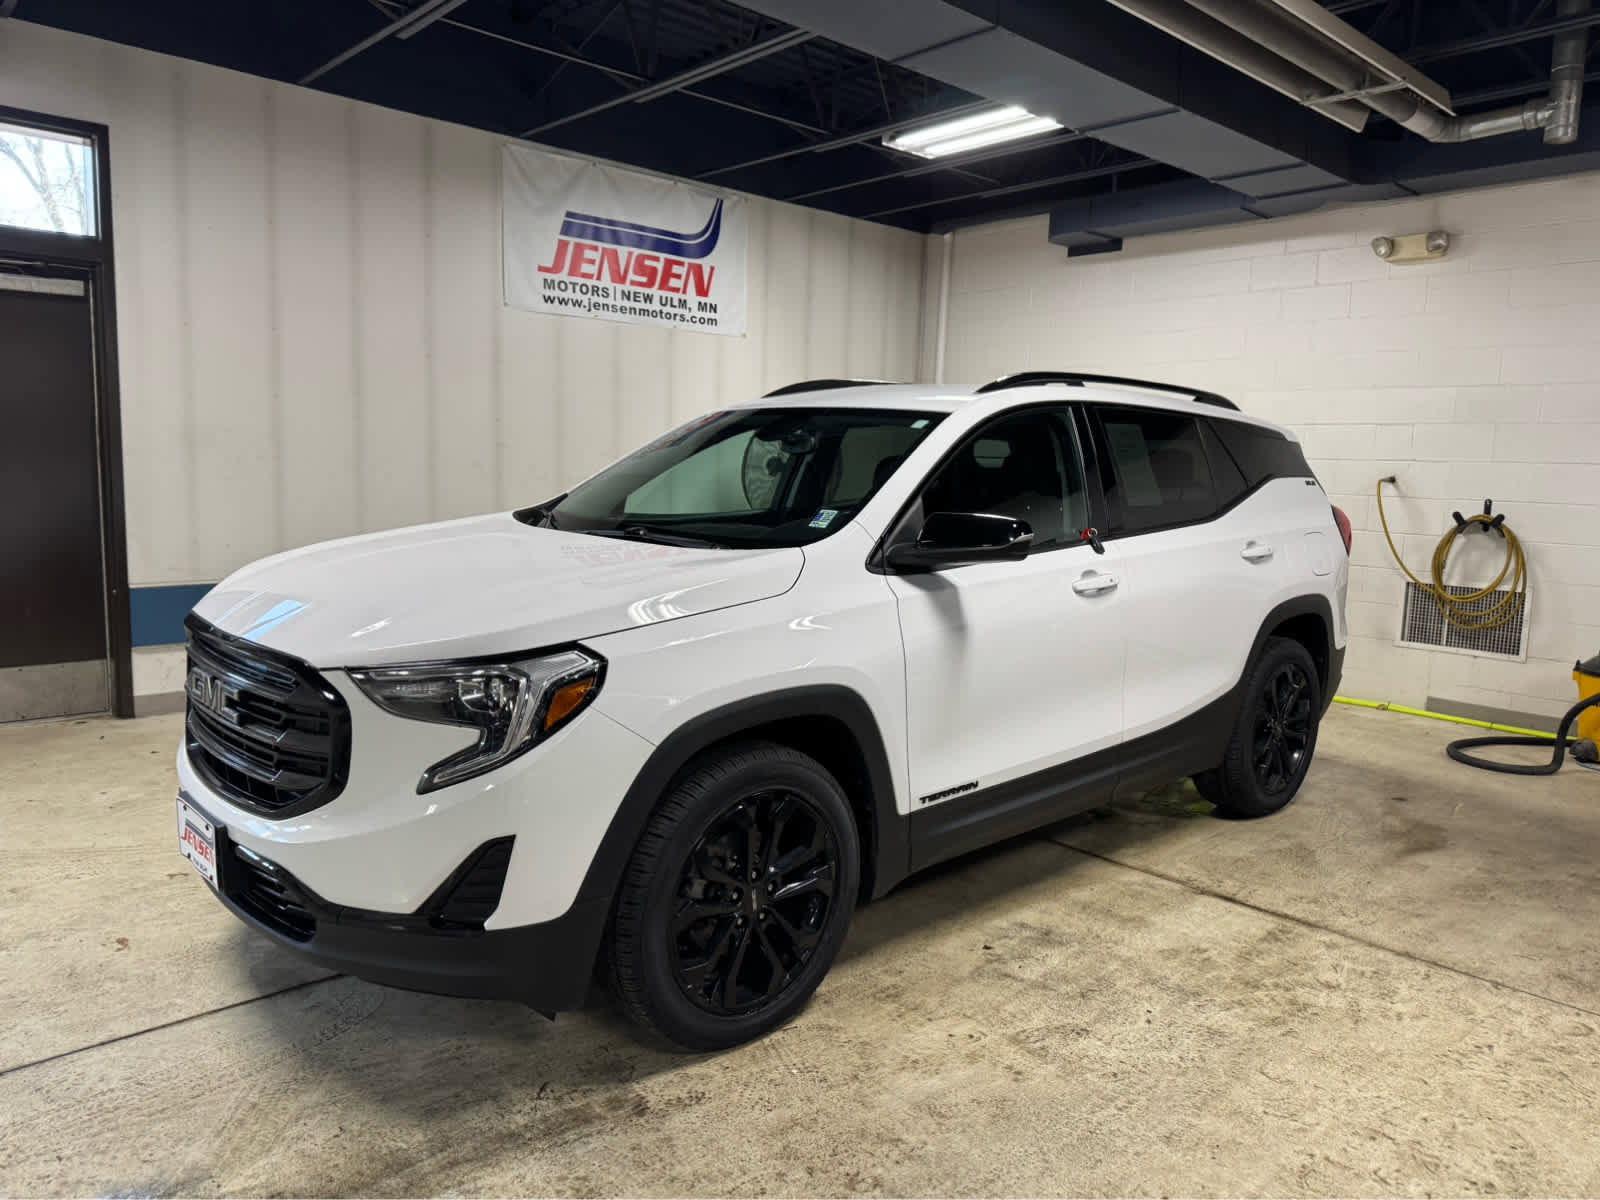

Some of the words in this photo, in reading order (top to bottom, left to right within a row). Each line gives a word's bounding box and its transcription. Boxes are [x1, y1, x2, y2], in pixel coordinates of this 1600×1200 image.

[537, 238, 715, 298] JENSEN
[542, 293, 718, 327] www.jensenmotors.com
[543, 278, 610, 299] MOTORS
[621, 289, 654, 305] NEW
[659, 295, 692, 313] ULM,
[698, 301, 718, 314] MN
[188, 667, 239, 723] GMC
